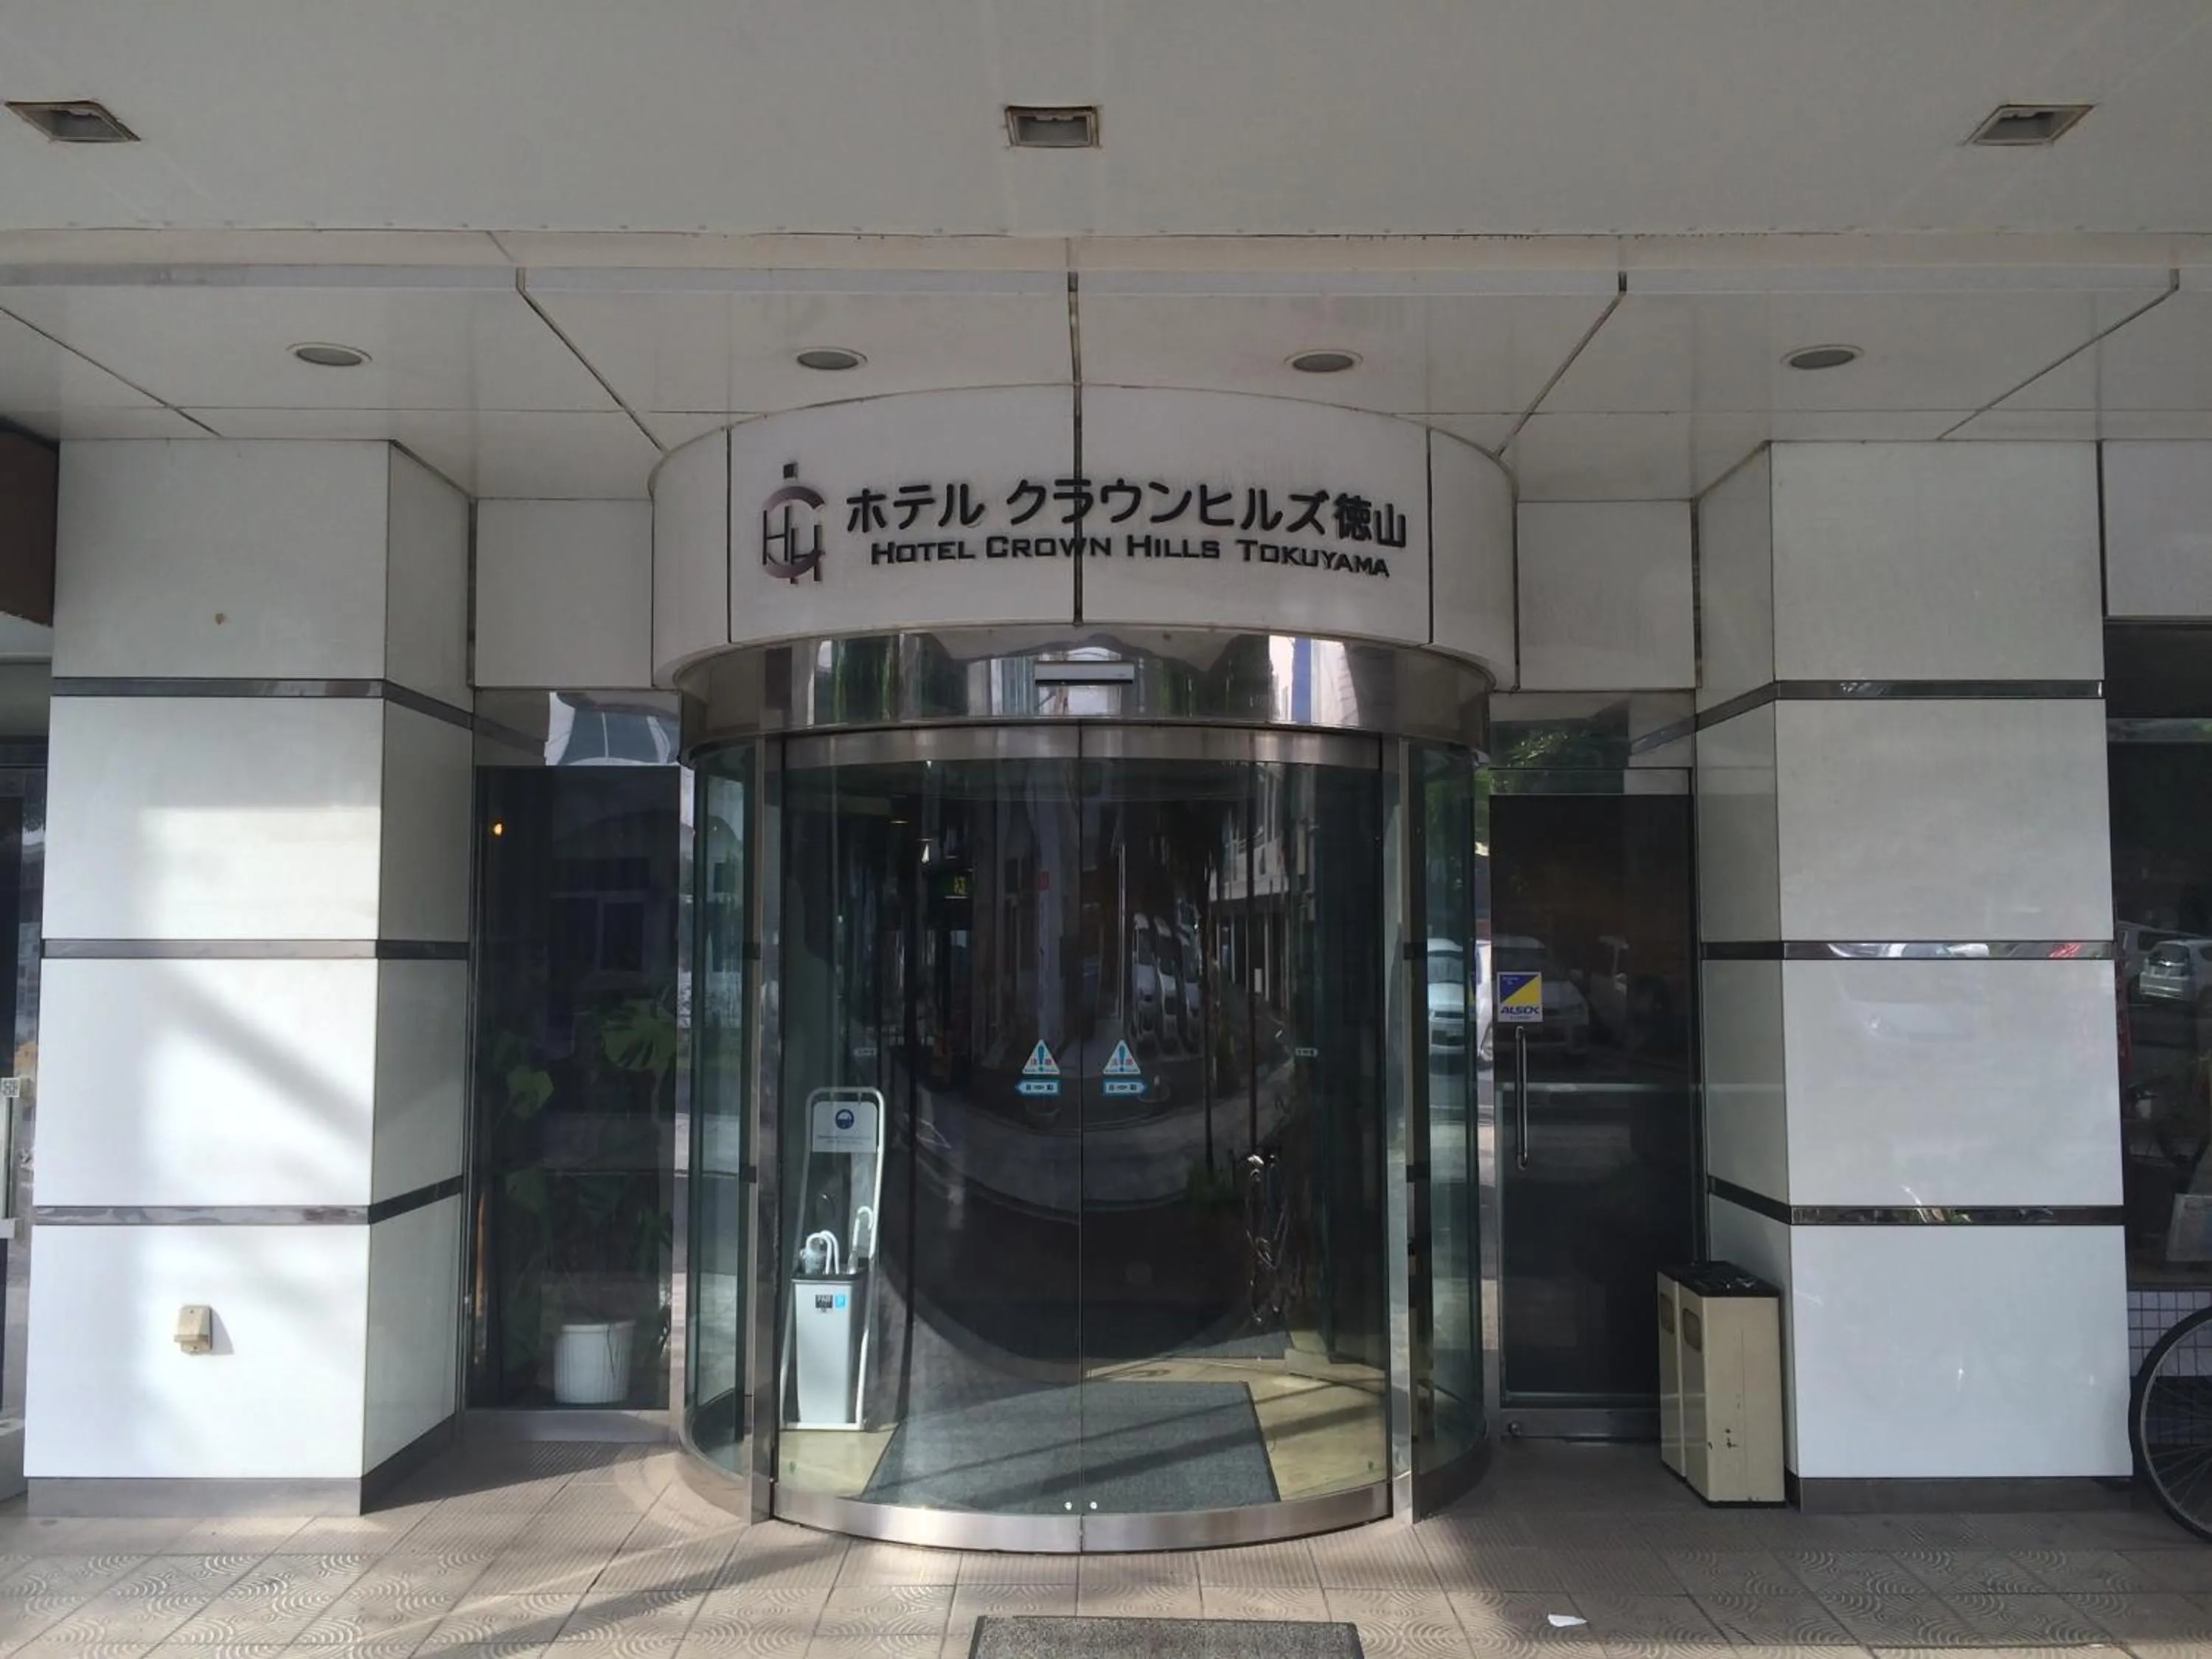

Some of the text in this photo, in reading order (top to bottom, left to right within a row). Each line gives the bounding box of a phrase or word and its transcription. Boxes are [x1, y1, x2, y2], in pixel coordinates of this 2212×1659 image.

[846, 481, 985, 532] ホテル
[871, 534, 1391, 578] HOTEL CROWN HILLS TOKUYAMA
